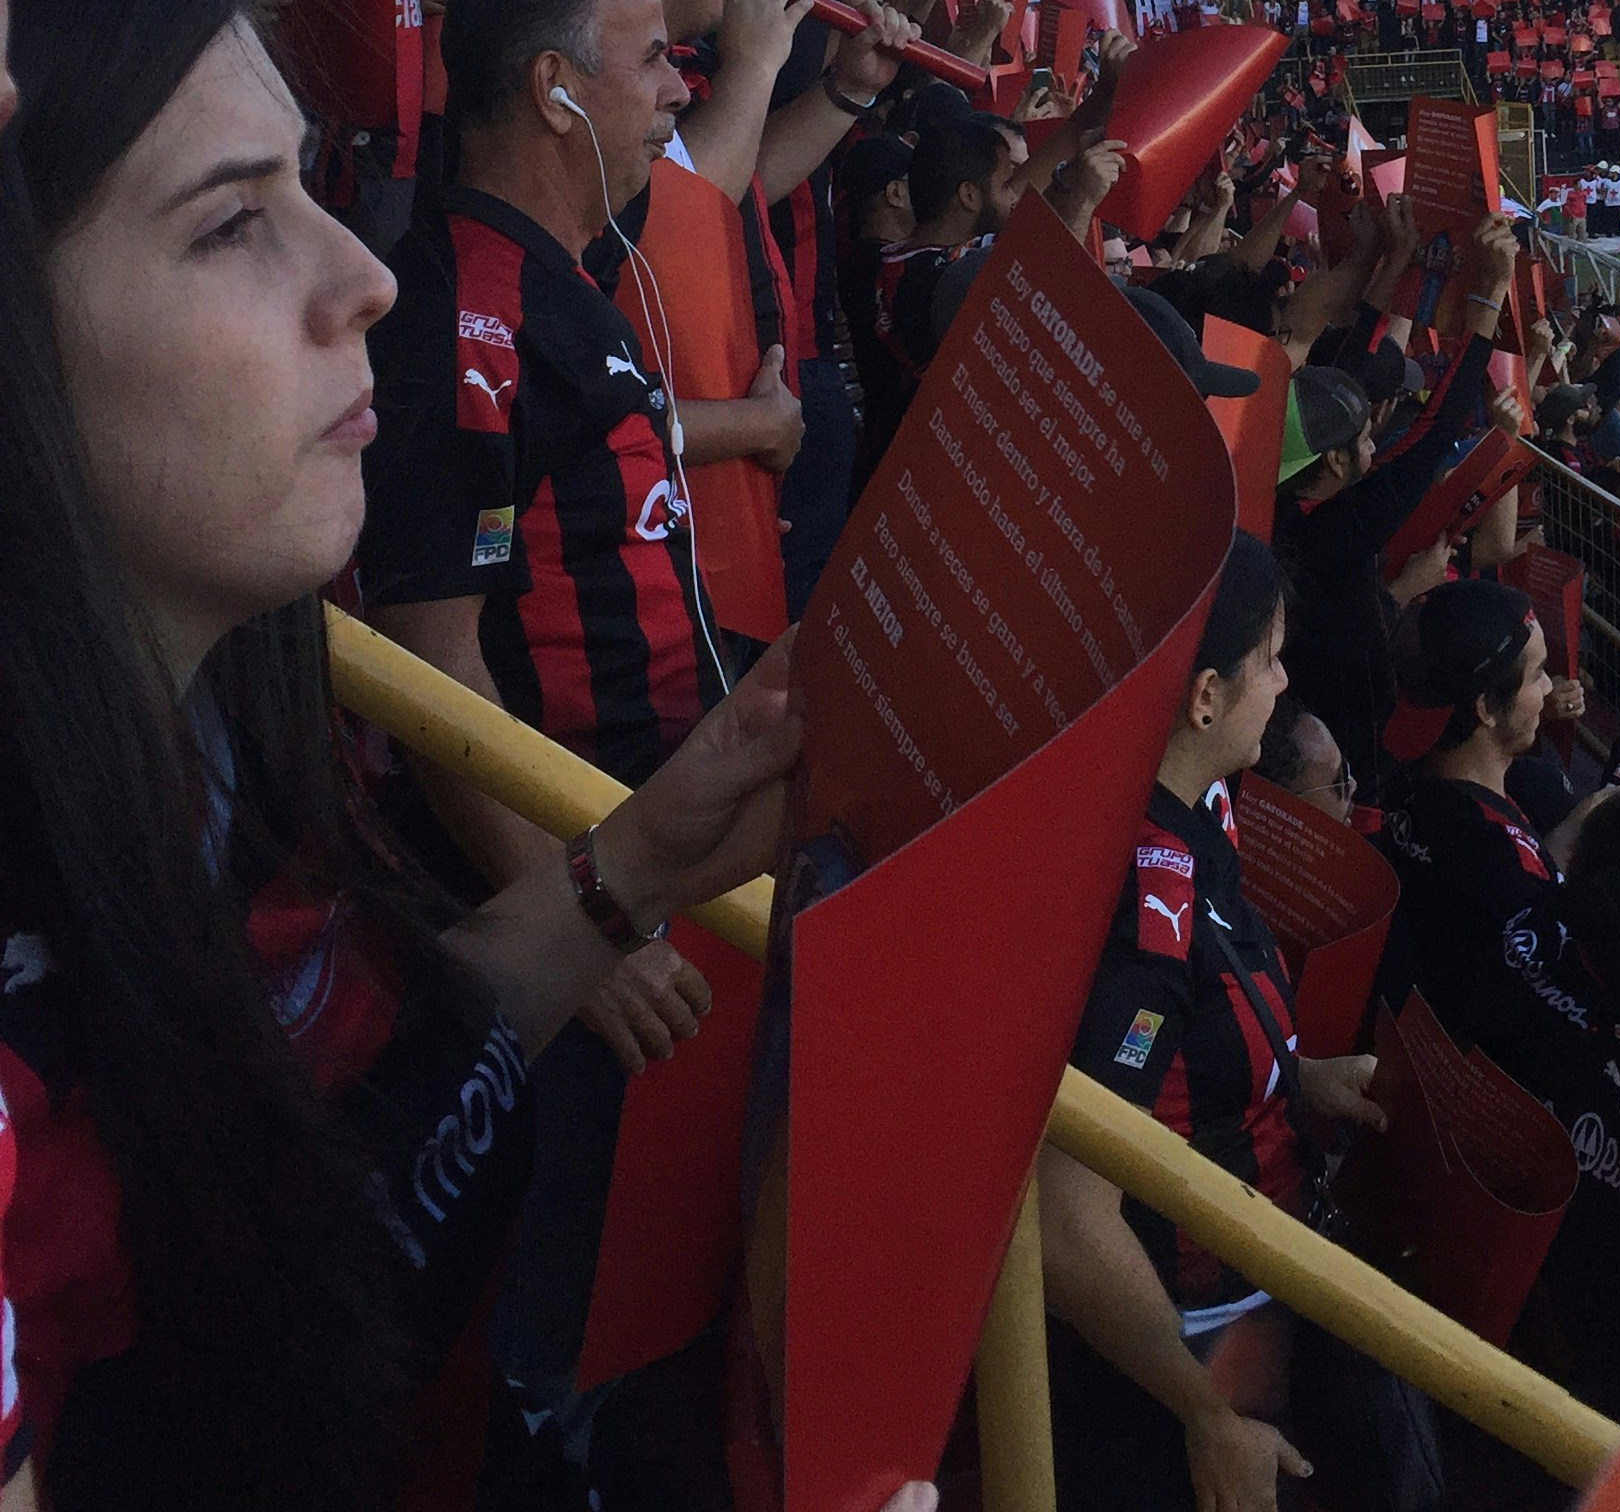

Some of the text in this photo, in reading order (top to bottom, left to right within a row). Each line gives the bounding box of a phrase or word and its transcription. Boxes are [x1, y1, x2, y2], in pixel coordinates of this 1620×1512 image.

[972, 322, 1096, 494] buscado ser el mejor.
[989, 295, 1126, 477] equipo que siempre ha
[1006, 259, 1171, 483] Hoy GATORADE se une un
[474, 544, 511, 564] FPD
[896, 469, 1034, 680] Donde veces se gana y
[928, 407, 1080, 635] Dando todo hasta el último
[951, 363, 1116, 597] El mejor dentro y fuera de la
[849, 555, 904, 649] EL MEJOR
[872, 512, 1020, 738] Pero siempre se busca ser
[834, 620, 943, 796] el mejor siempre se
